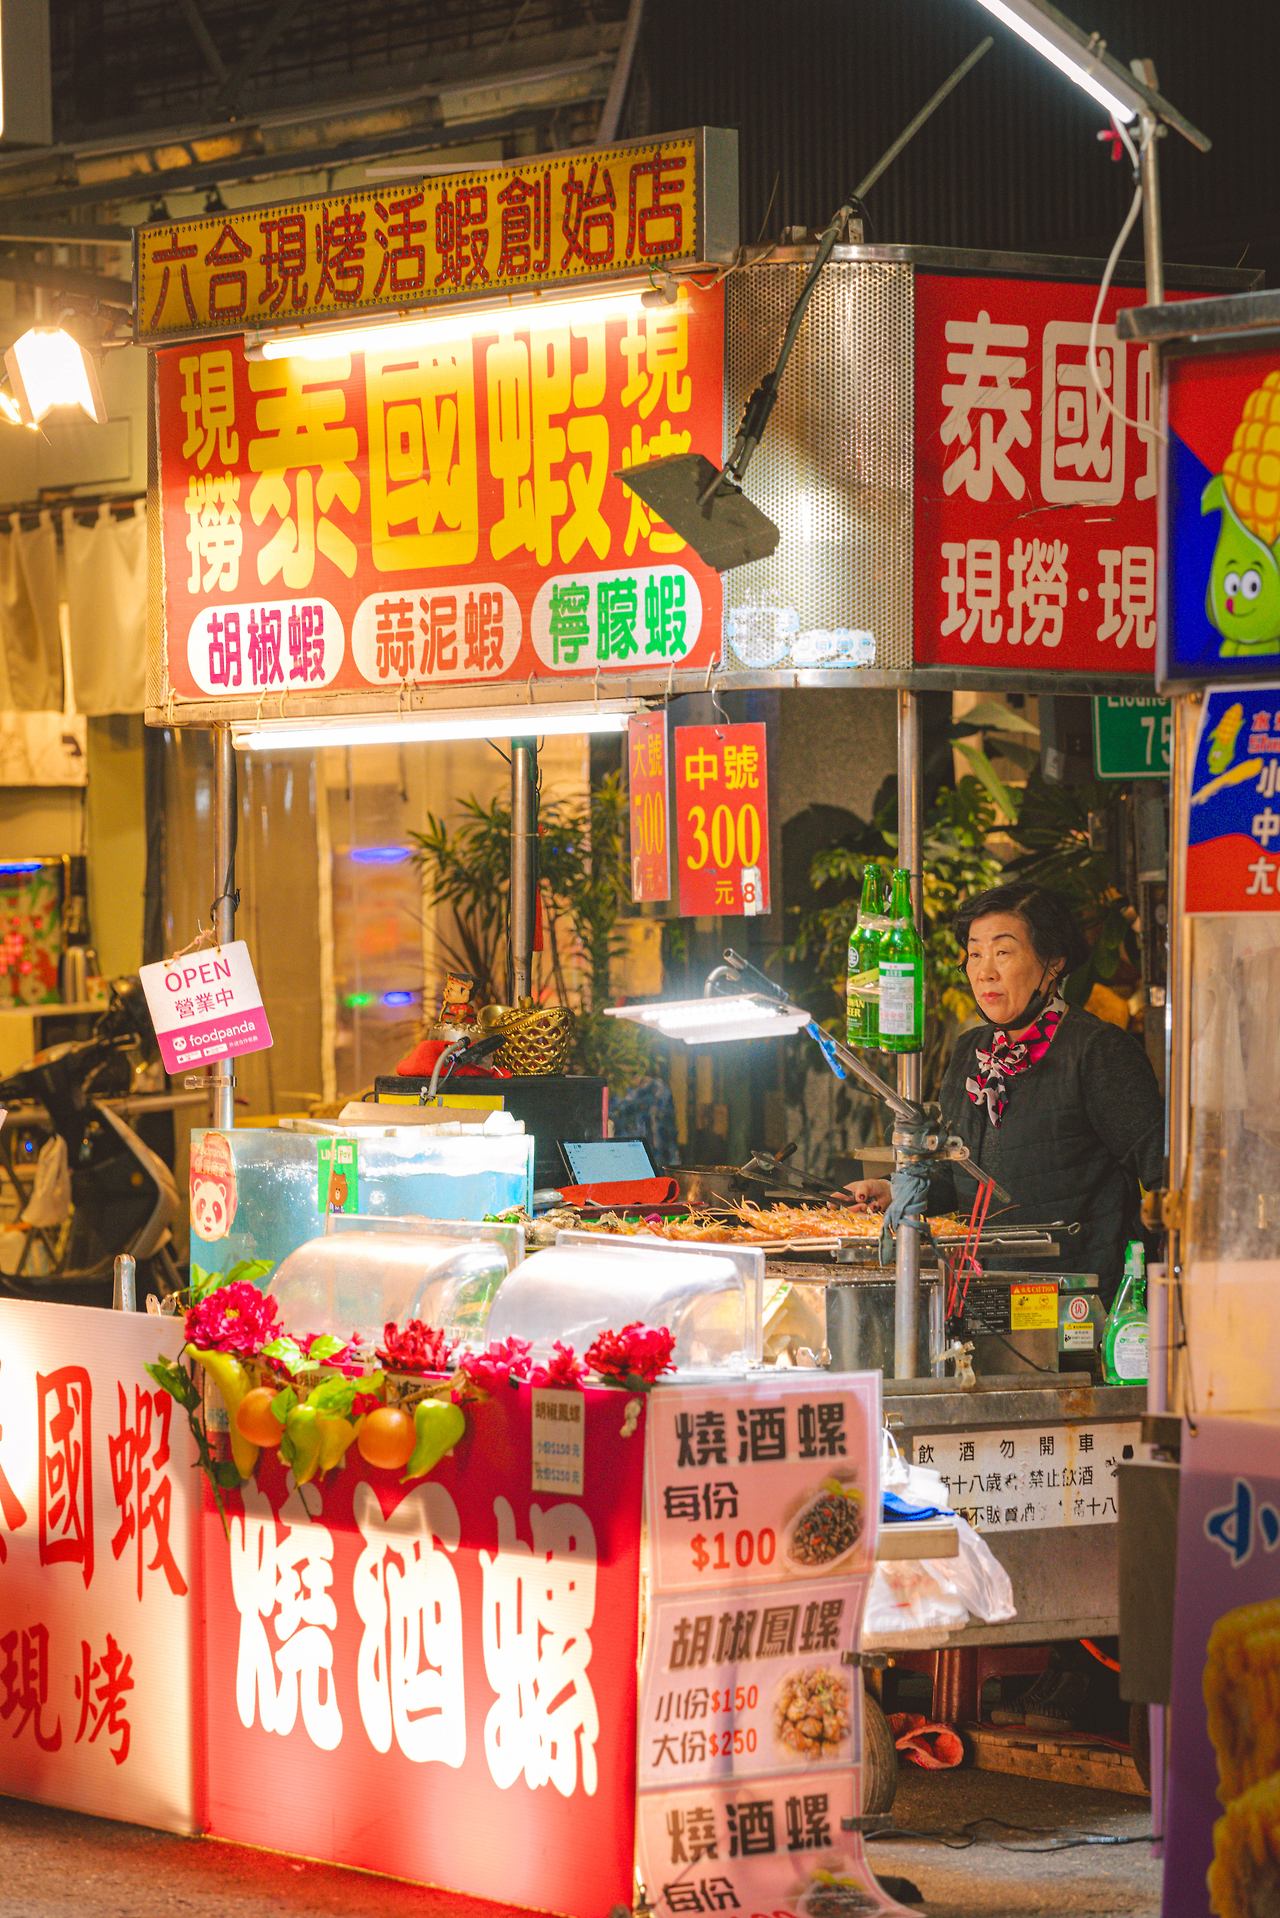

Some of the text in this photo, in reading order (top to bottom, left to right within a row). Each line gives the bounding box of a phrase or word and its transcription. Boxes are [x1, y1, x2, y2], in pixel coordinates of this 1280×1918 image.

[152, 151, 687, 327] 六合現烤活蝦創始店
[180, 348, 244, 596] 現撈
[247, 318, 612, 591] 泰國蝦
[206, 600, 327, 689] 胡椒蝦
[375, 590, 504, 678] 蒜泥蝦
[685, 744, 760, 791] 中號
[687, 803, 761, 869] 300
[715, 880, 735, 905] 元
[165, 958, 232, 992] OPEN
[175, 987, 235, 1019] 營業中
[189, 1020, 256, 1047] foodpanda
[675, 1402, 848, 1468] 燒酒螺
[918, 1433, 1095, 1465] 飲酒勿開車
[664, 1482, 739, 1522] 每份
[690, 1528, 777, 1572] $100
[230, 1473, 600, 1798] 燒酒螺
[669, 1599, 845, 1671] 胡椒鳳螺
[0, 1622, 136, 1767] 現烤
[667, 1793, 833, 1865] 燒酒螺
[663, 1876, 742, 1913] 每份
